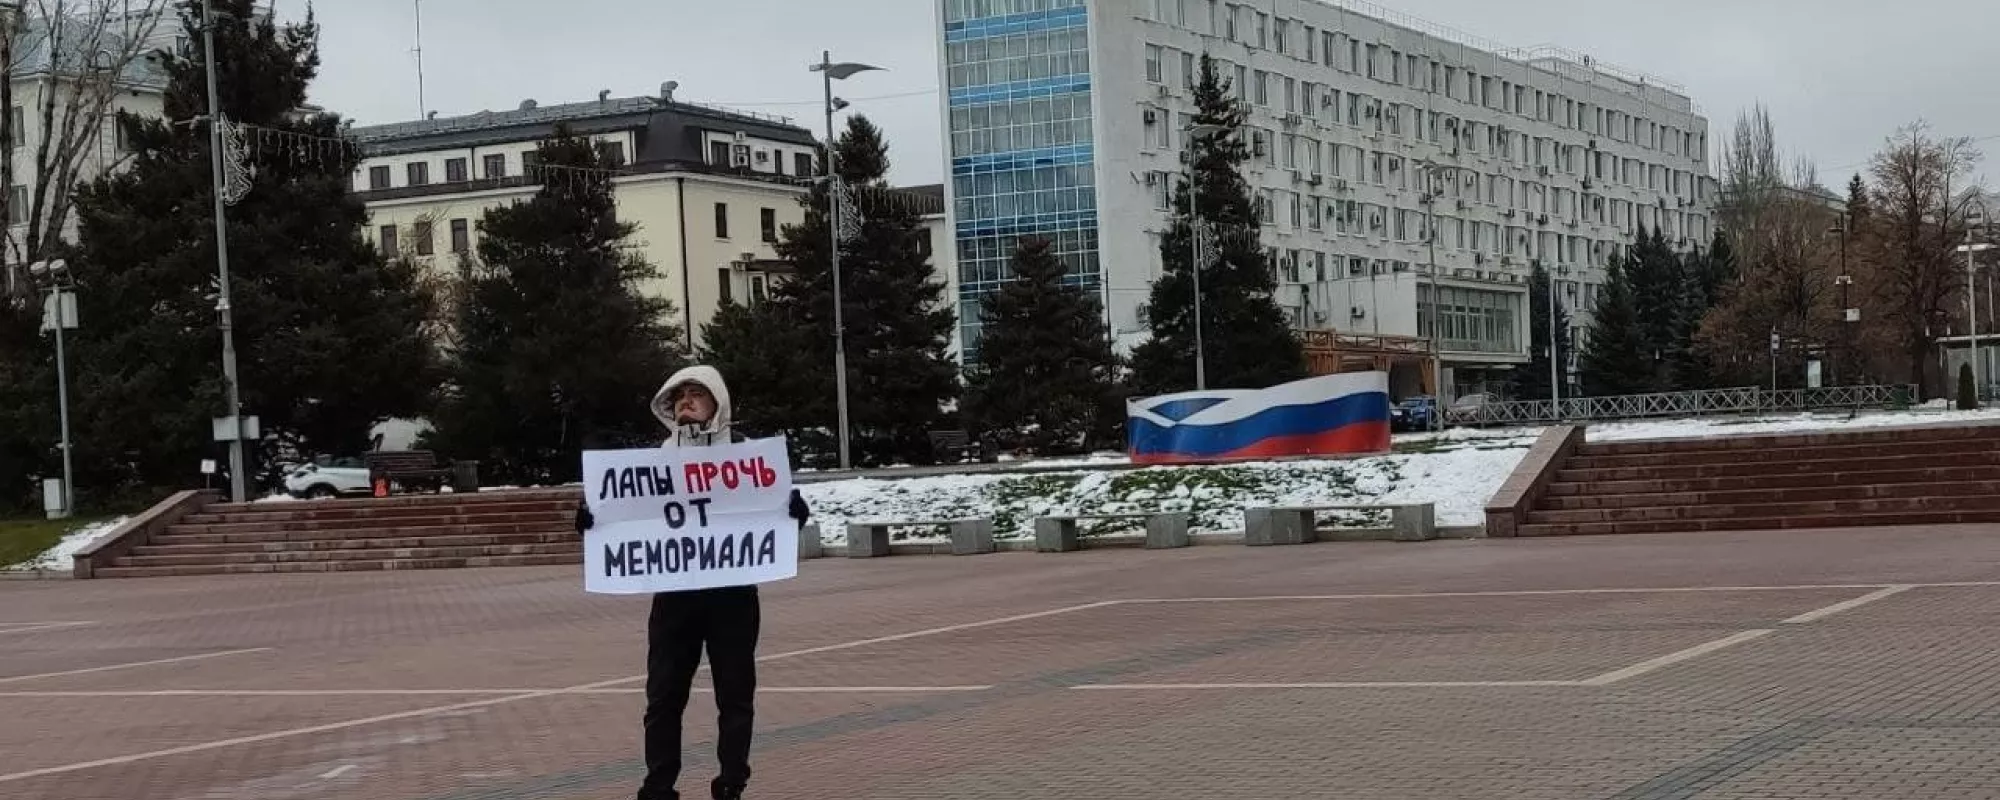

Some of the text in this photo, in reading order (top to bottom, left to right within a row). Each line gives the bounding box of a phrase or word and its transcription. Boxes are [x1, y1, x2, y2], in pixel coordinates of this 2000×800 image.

[600, 456, 776, 499] ЛАПЫ ПРОЧЬ
[664, 498, 711, 529] ОТ
[604, 529, 776, 577] МЕМОРИАЛА
